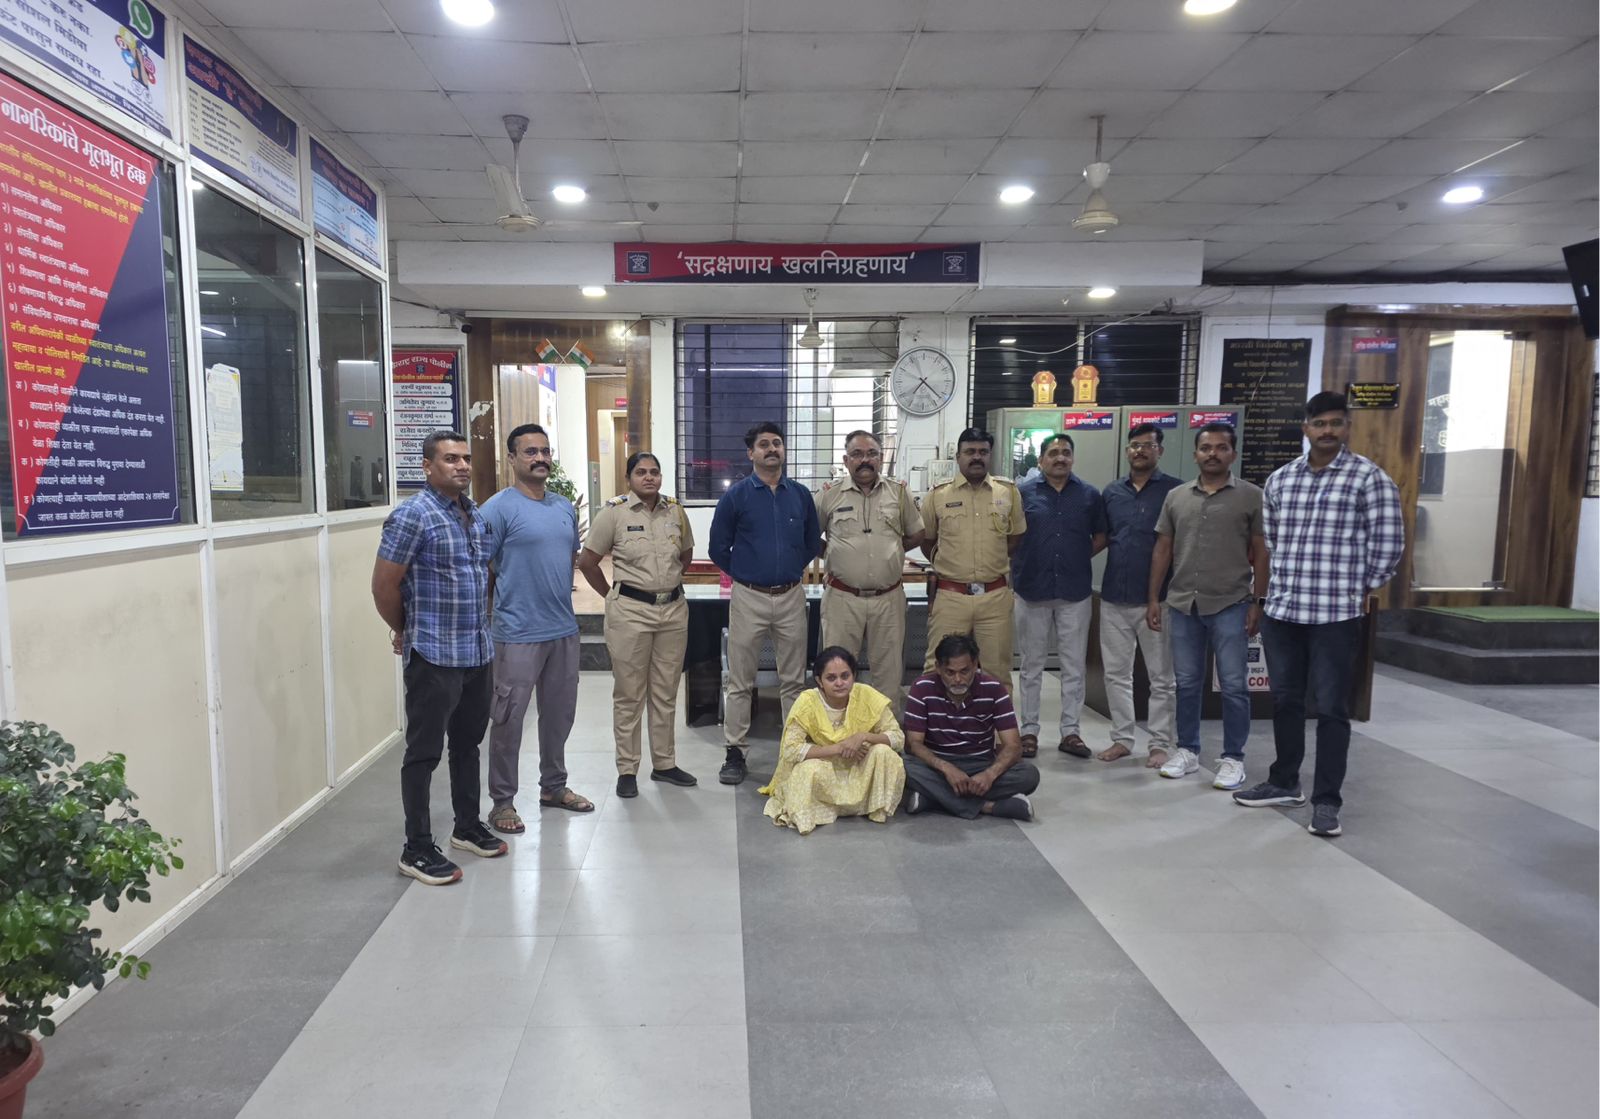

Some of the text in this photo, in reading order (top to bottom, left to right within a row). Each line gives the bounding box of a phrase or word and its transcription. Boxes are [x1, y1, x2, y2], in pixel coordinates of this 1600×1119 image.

[1, 101, 78, 153] नागरिकांचे
[82, 140, 124, 179] मूलभूत
[126, 162, 146, 185] हक्क
